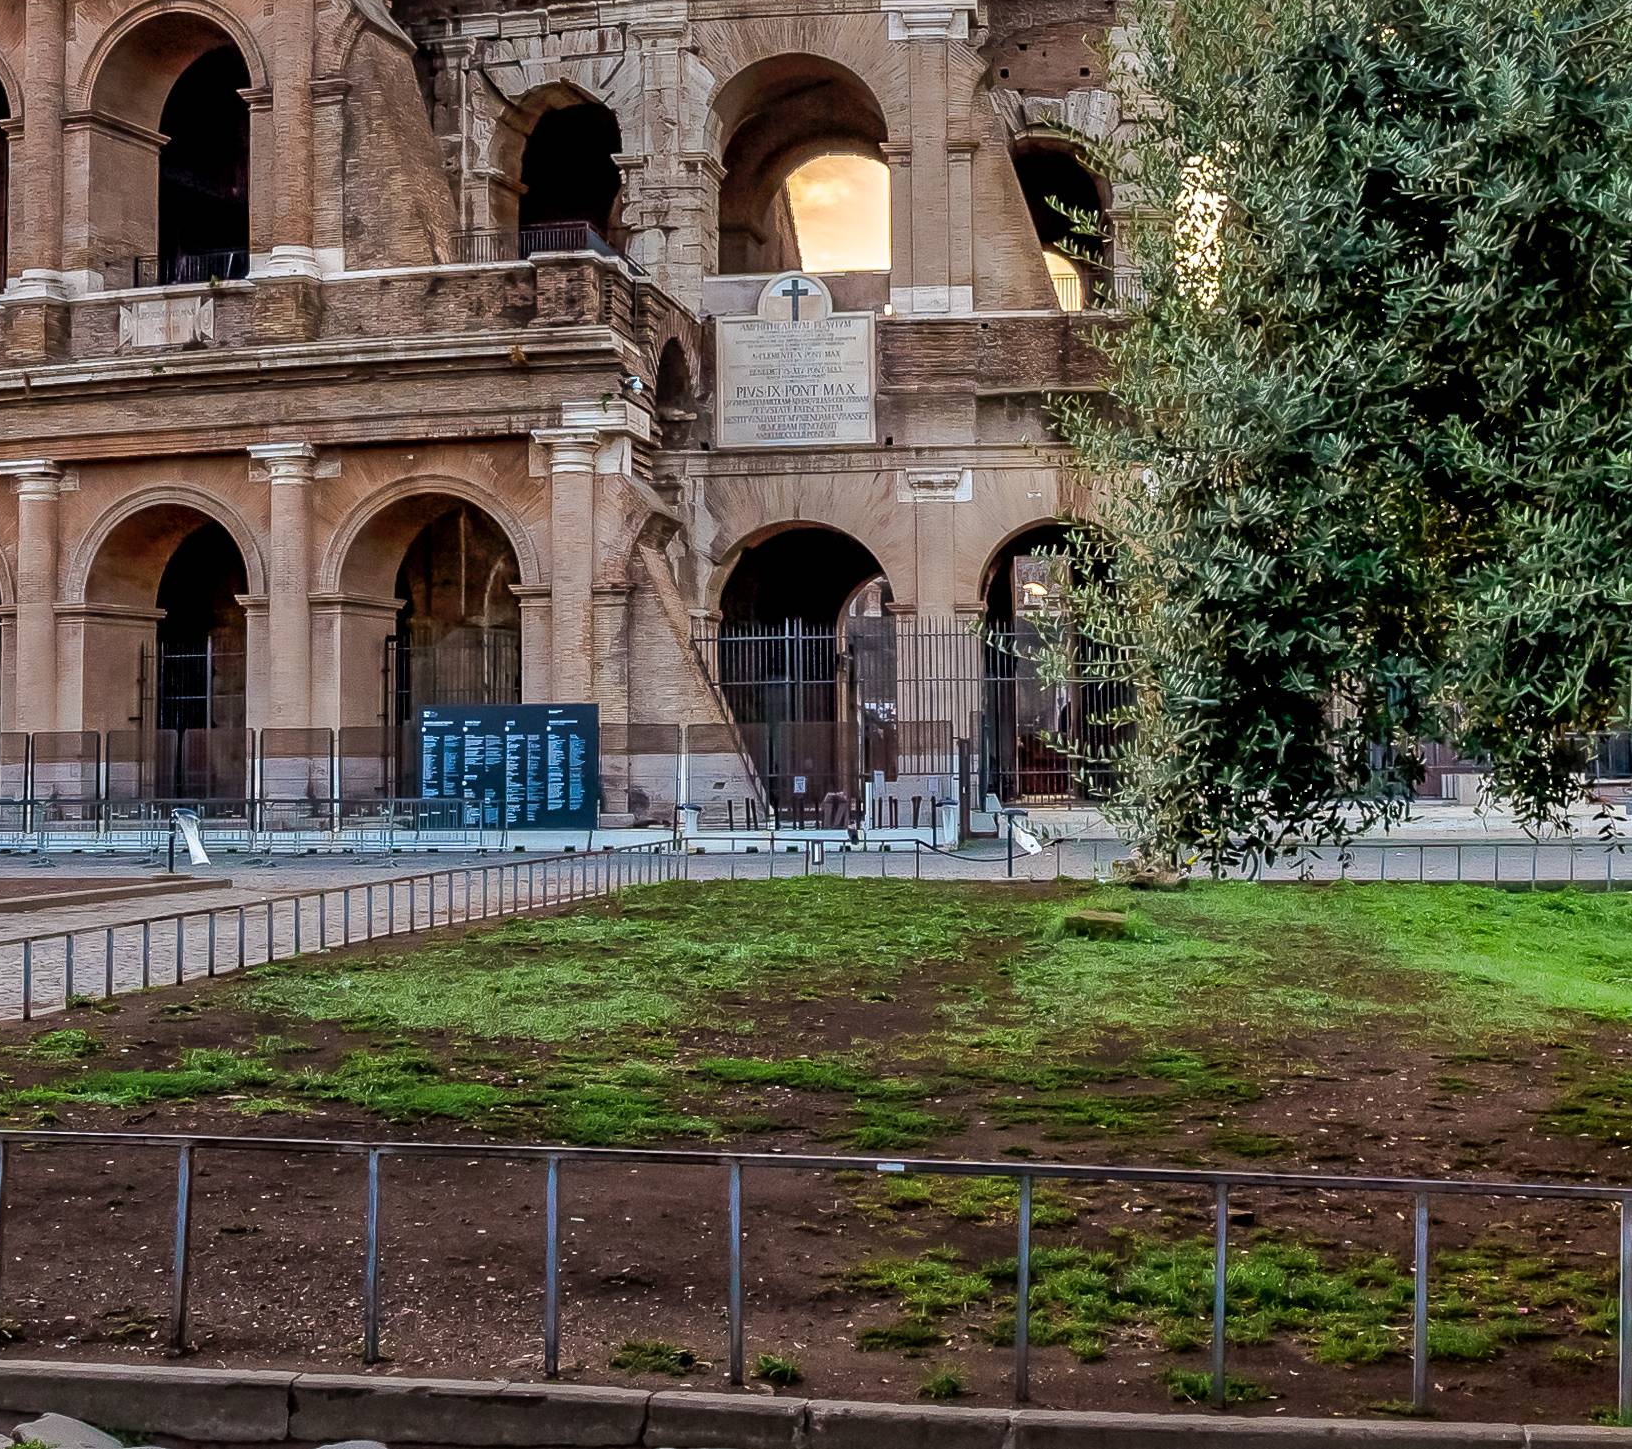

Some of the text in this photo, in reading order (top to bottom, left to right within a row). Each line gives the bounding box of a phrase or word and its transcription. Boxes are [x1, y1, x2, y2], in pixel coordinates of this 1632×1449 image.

[736, 386, 764, 398] PIVS
[785, 384, 818, 396] PONT
[823, 383, 856, 396] MAX
